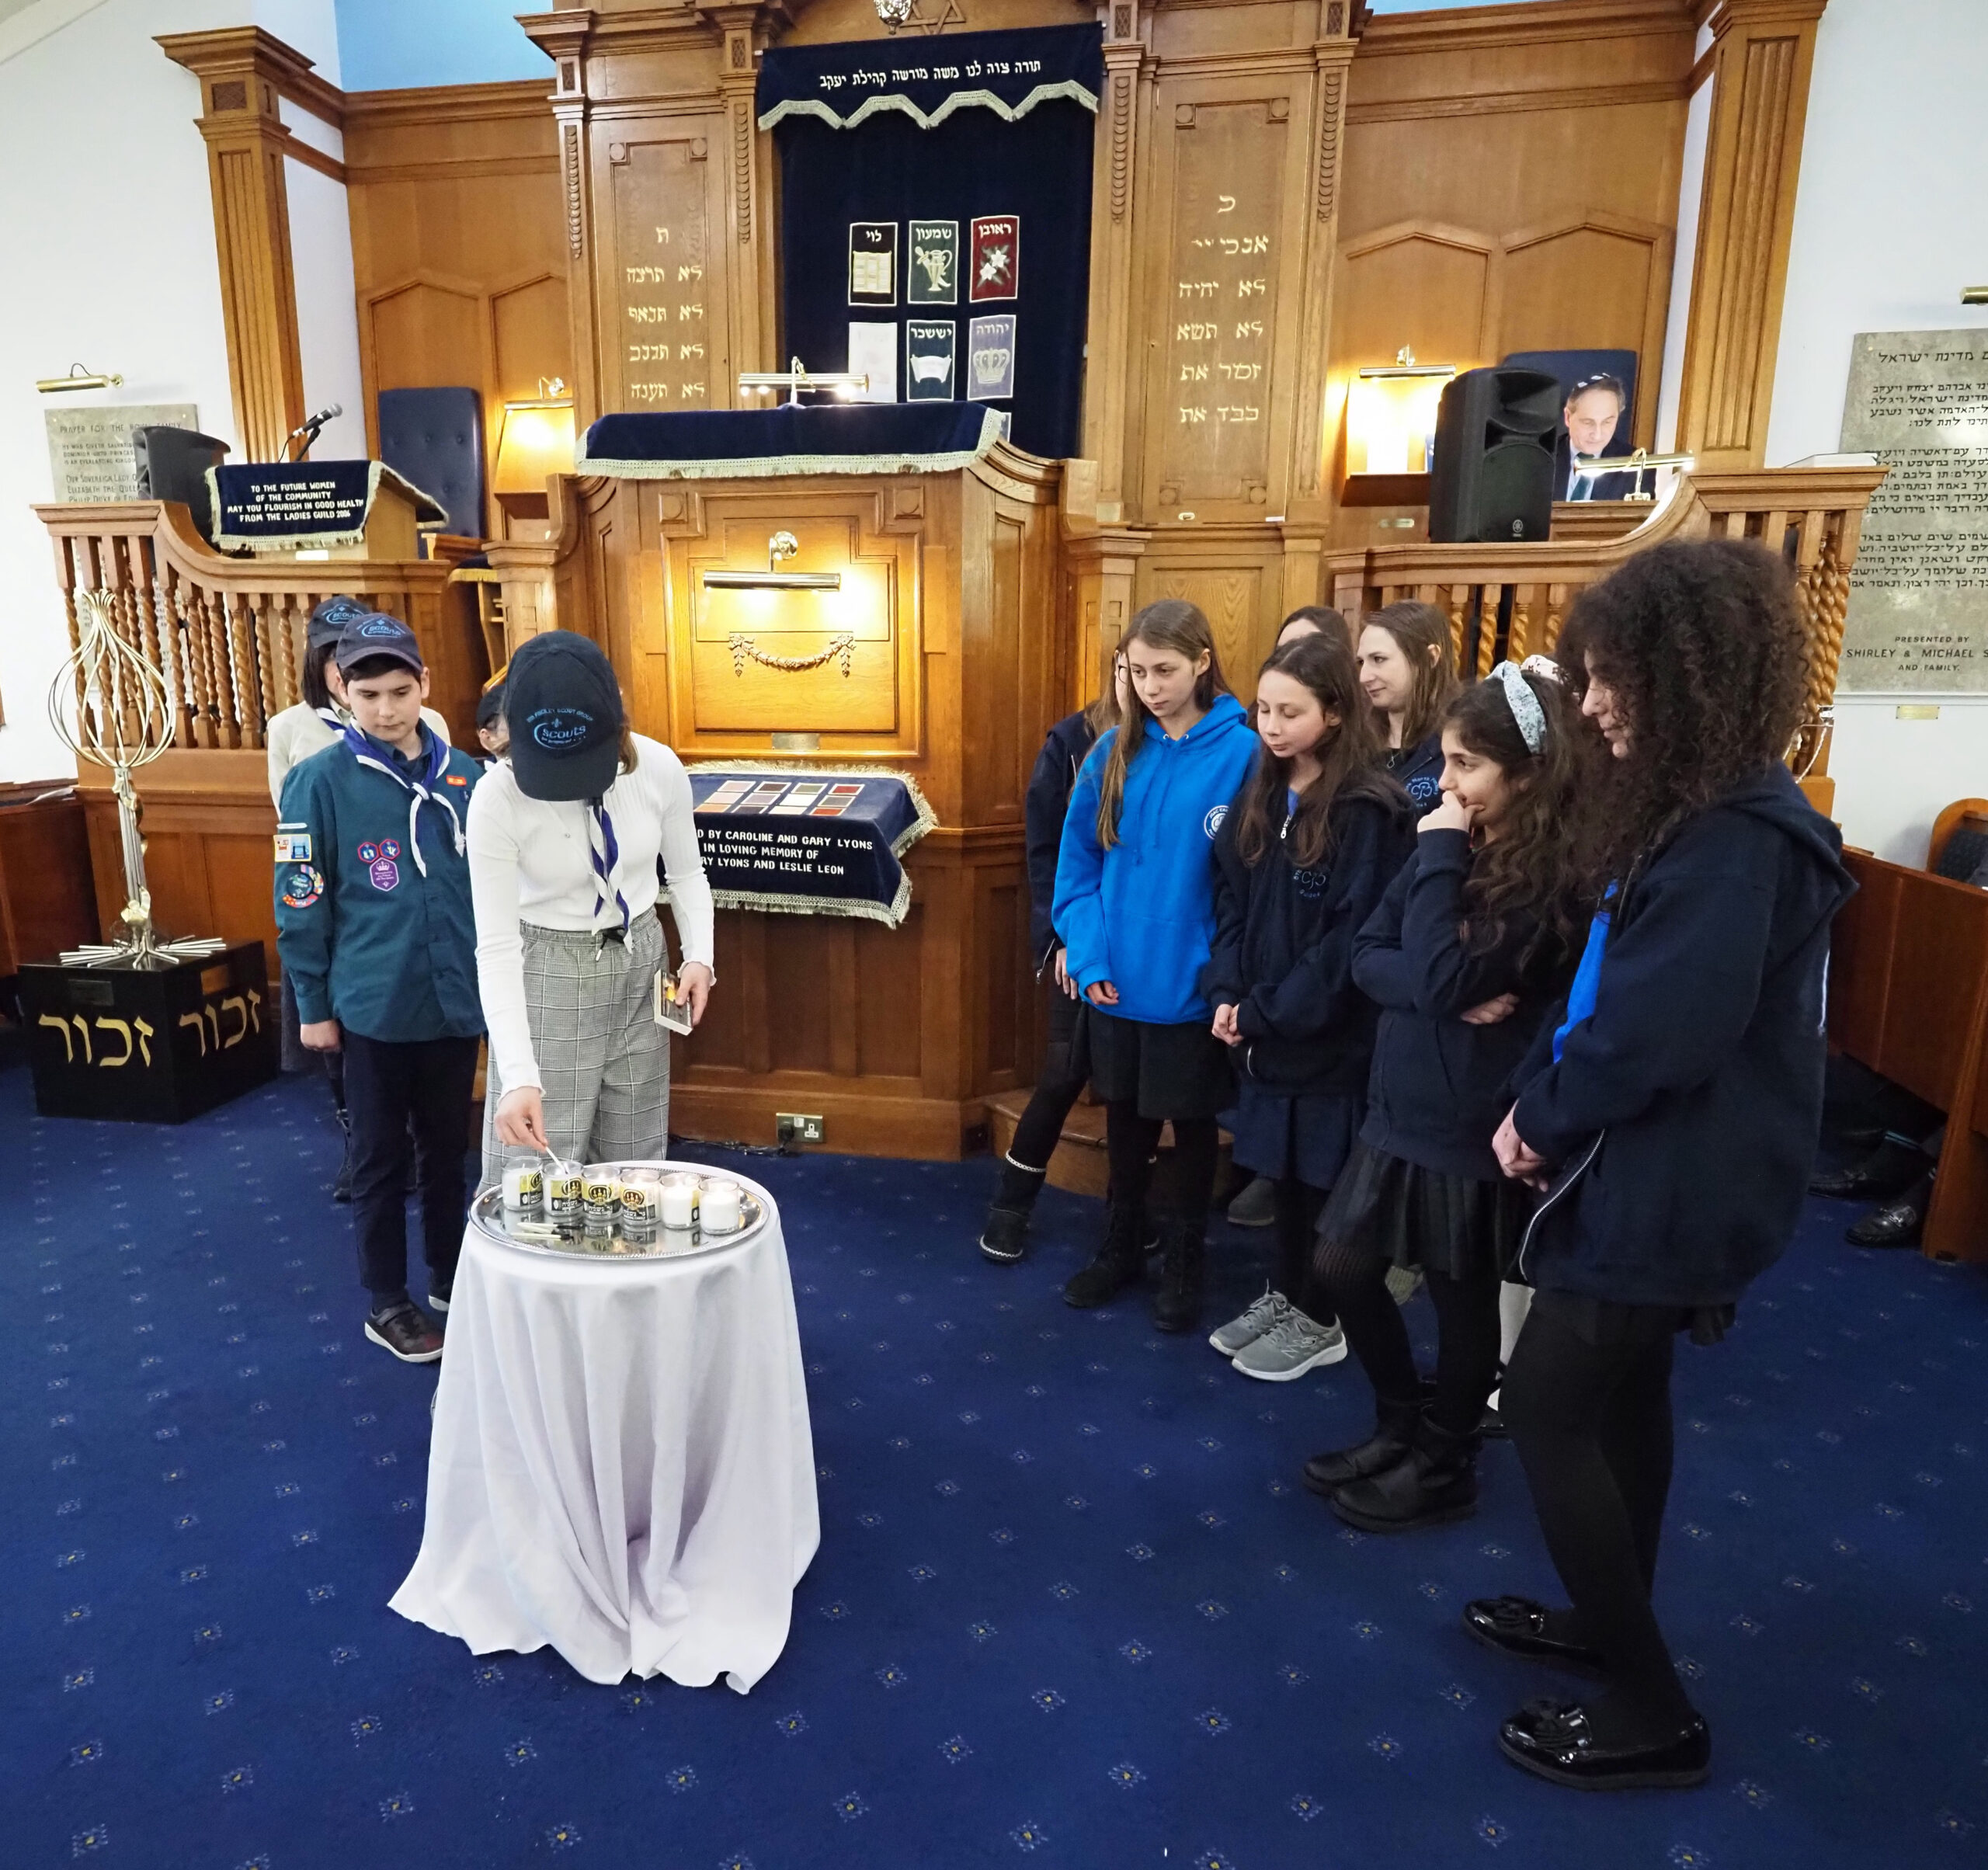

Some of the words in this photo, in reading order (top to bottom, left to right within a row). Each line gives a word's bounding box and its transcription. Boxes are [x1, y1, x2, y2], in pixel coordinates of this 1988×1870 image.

[933, 65, 959, 80] משה
[966, 59, 982, 76] לנו
[986, 62, 1010, 75] צוה
[1015, 60, 1041, 73] תורה
[820, 75, 846, 90] יעקב
[853, 69, 886, 86] קהילת
[892, 68, 928, 82] מורשה
[866, 228, 882, 243] לוי
[916, 227, 951, 241] שמעון
[978, 223, 1011, 238] ראובן
[1220, 235, 1268, 254] אנכי
[678, 265, 702, 281] לא
[1239, 279, 1265, 297] לא
[679, 304, 703, 321] לא
[911, 327, 952, 339] יששכר
[976, 324, 1009, 335] יהודה
[1177, 322, 1217, 340] תשא
[1236, 321, 1263, 339] לא
[680, 344, 704, 360] לא
[1879, 353, 1928, 363] ישראל
[1935, 352, 1974, 362] מדינת
[1180, 364, 1208, 381] את
[681, 382, 704, 398] לא
[1180, 406, 1207, 422] את
[1870, 408, 1902, 418] נשבע
[1937, 417, 1961, 426] לתת
[251, 485, 260, 493] TO
[263, 484, 277, 492] THE
[280, 482, 307, 492] FUTURE
[310, 481, 335, 490] WOMEN
[255, 494, 265, 502] OF
[269, 493, 282, 502] THE
[285, 491, 331, 501] COMMUNITY
[227, 505, 243, 513] MAY
[246, 504, 262, 513] YOU
[265, 502, 301, 512] FLOURISH
[304, 501, 312, 509] IN
[315, 501, 335, 509] GOOD
[337, 499, 363, 508] HEALTH
[240, 513, 263, 523] FROM
[266, 513, 280, 521] THE
[284, 512, 311, 520] LADIES
[313, 510, 335, 520] GUILD
[1888, 533, 1921, 541] שלום
[1890, 557, 1913, 565] ואין
[1924, 566, 1966, 576] שלומך
[1847, 649, 1896, 658] SHIRLEY
[1921, 649, 1974, 658] MICHAEL
[708, 829, 722, 839] BY
[725, 830, 773, 843] CAROLINE
[777, 834, 798, 844] AND
[801, 836, 831, 846] GARY
[837, 839, 873, 850] LYONS
[704, 843, 715, 853] IN
[720, 843, 757, 855] LOVING
[761, 846, 803, 859] MEMORY
[806, 849, 819, 860] OF
[718, 857, 749, 868] LYONS
[753, 859, 775, 870] AND
[780, 861, 812, 873] LESLIE
[818, 864, 844, 875] LEON
[179, 989, 261, 1057] זכור
[39, 1013, 154, 1068] זכור
